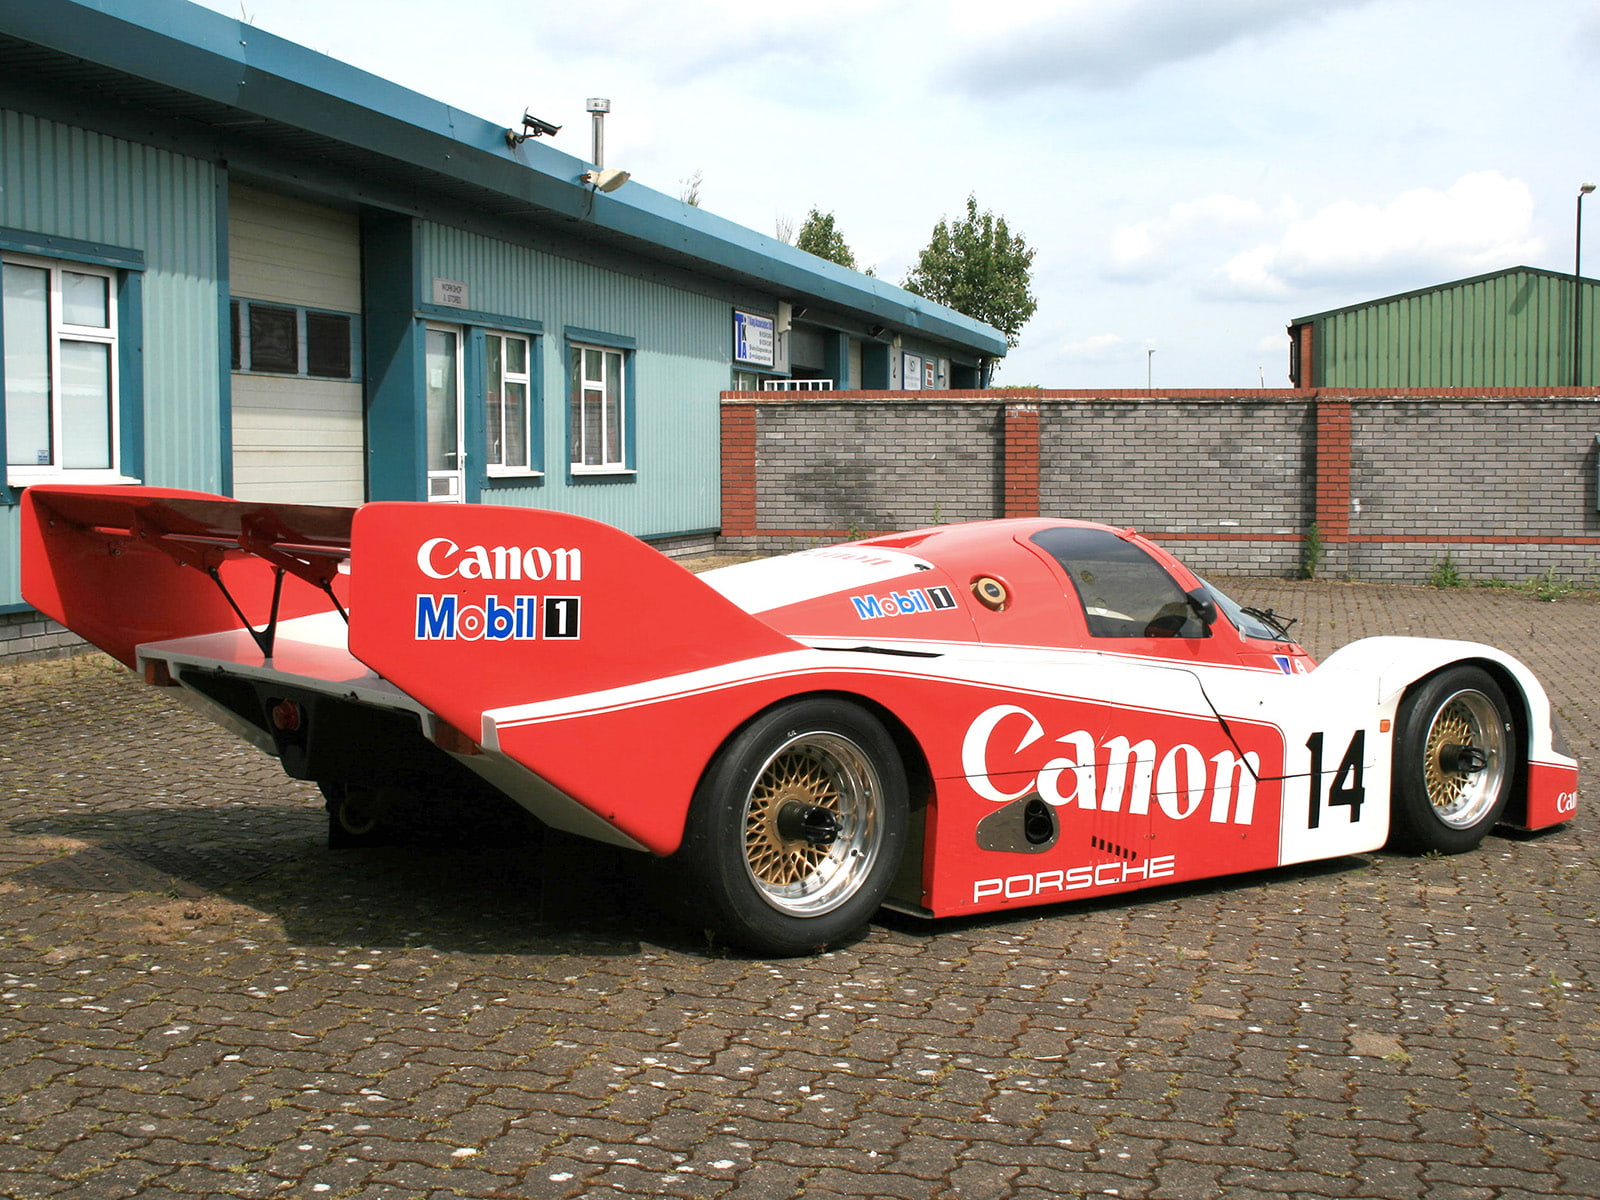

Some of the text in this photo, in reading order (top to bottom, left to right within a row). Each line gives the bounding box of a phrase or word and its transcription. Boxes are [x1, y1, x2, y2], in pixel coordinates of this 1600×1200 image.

[417, 537, 582, 581] Canon
[415, 594, 537, 641] Mobil
[851, 591, 932, 620] Mobil
[961, 704, 1261, 825] Canon
[1305, 729, 1366, 829] 14
[973, 855, 1175, 903] PORSCHE
